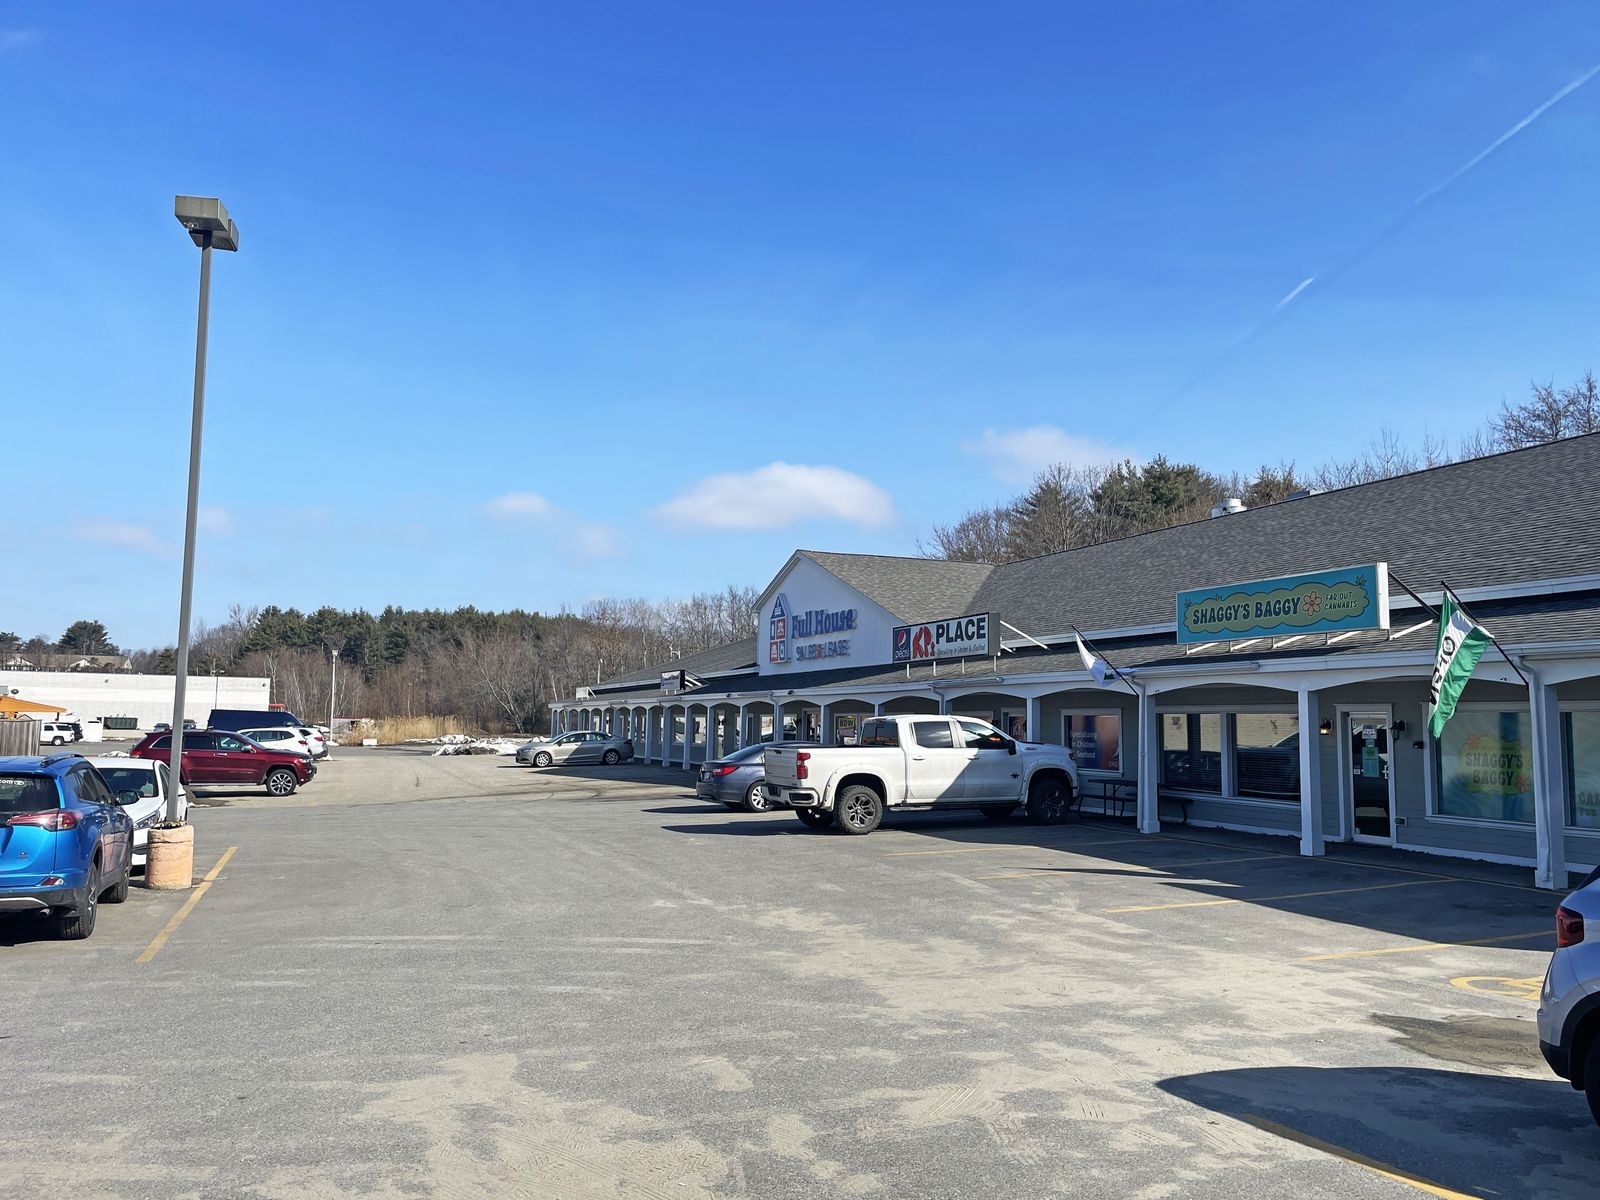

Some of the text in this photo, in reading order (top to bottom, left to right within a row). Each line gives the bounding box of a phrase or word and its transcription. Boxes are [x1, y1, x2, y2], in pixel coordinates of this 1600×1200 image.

[1325, 591, 1353, 601] FAR OUT
[1192, 597, 1301, 625] SHAGGY'S BAGGY
[1324, 600, 1358, 610] CANNABIS
[791, 608, 854, 640] Full House
[935, 616, 986, 645] PLACE
[1465, 752, 1524, 769] SHAGGY'S
[1472, 769, 1514, 786] BAGGY
